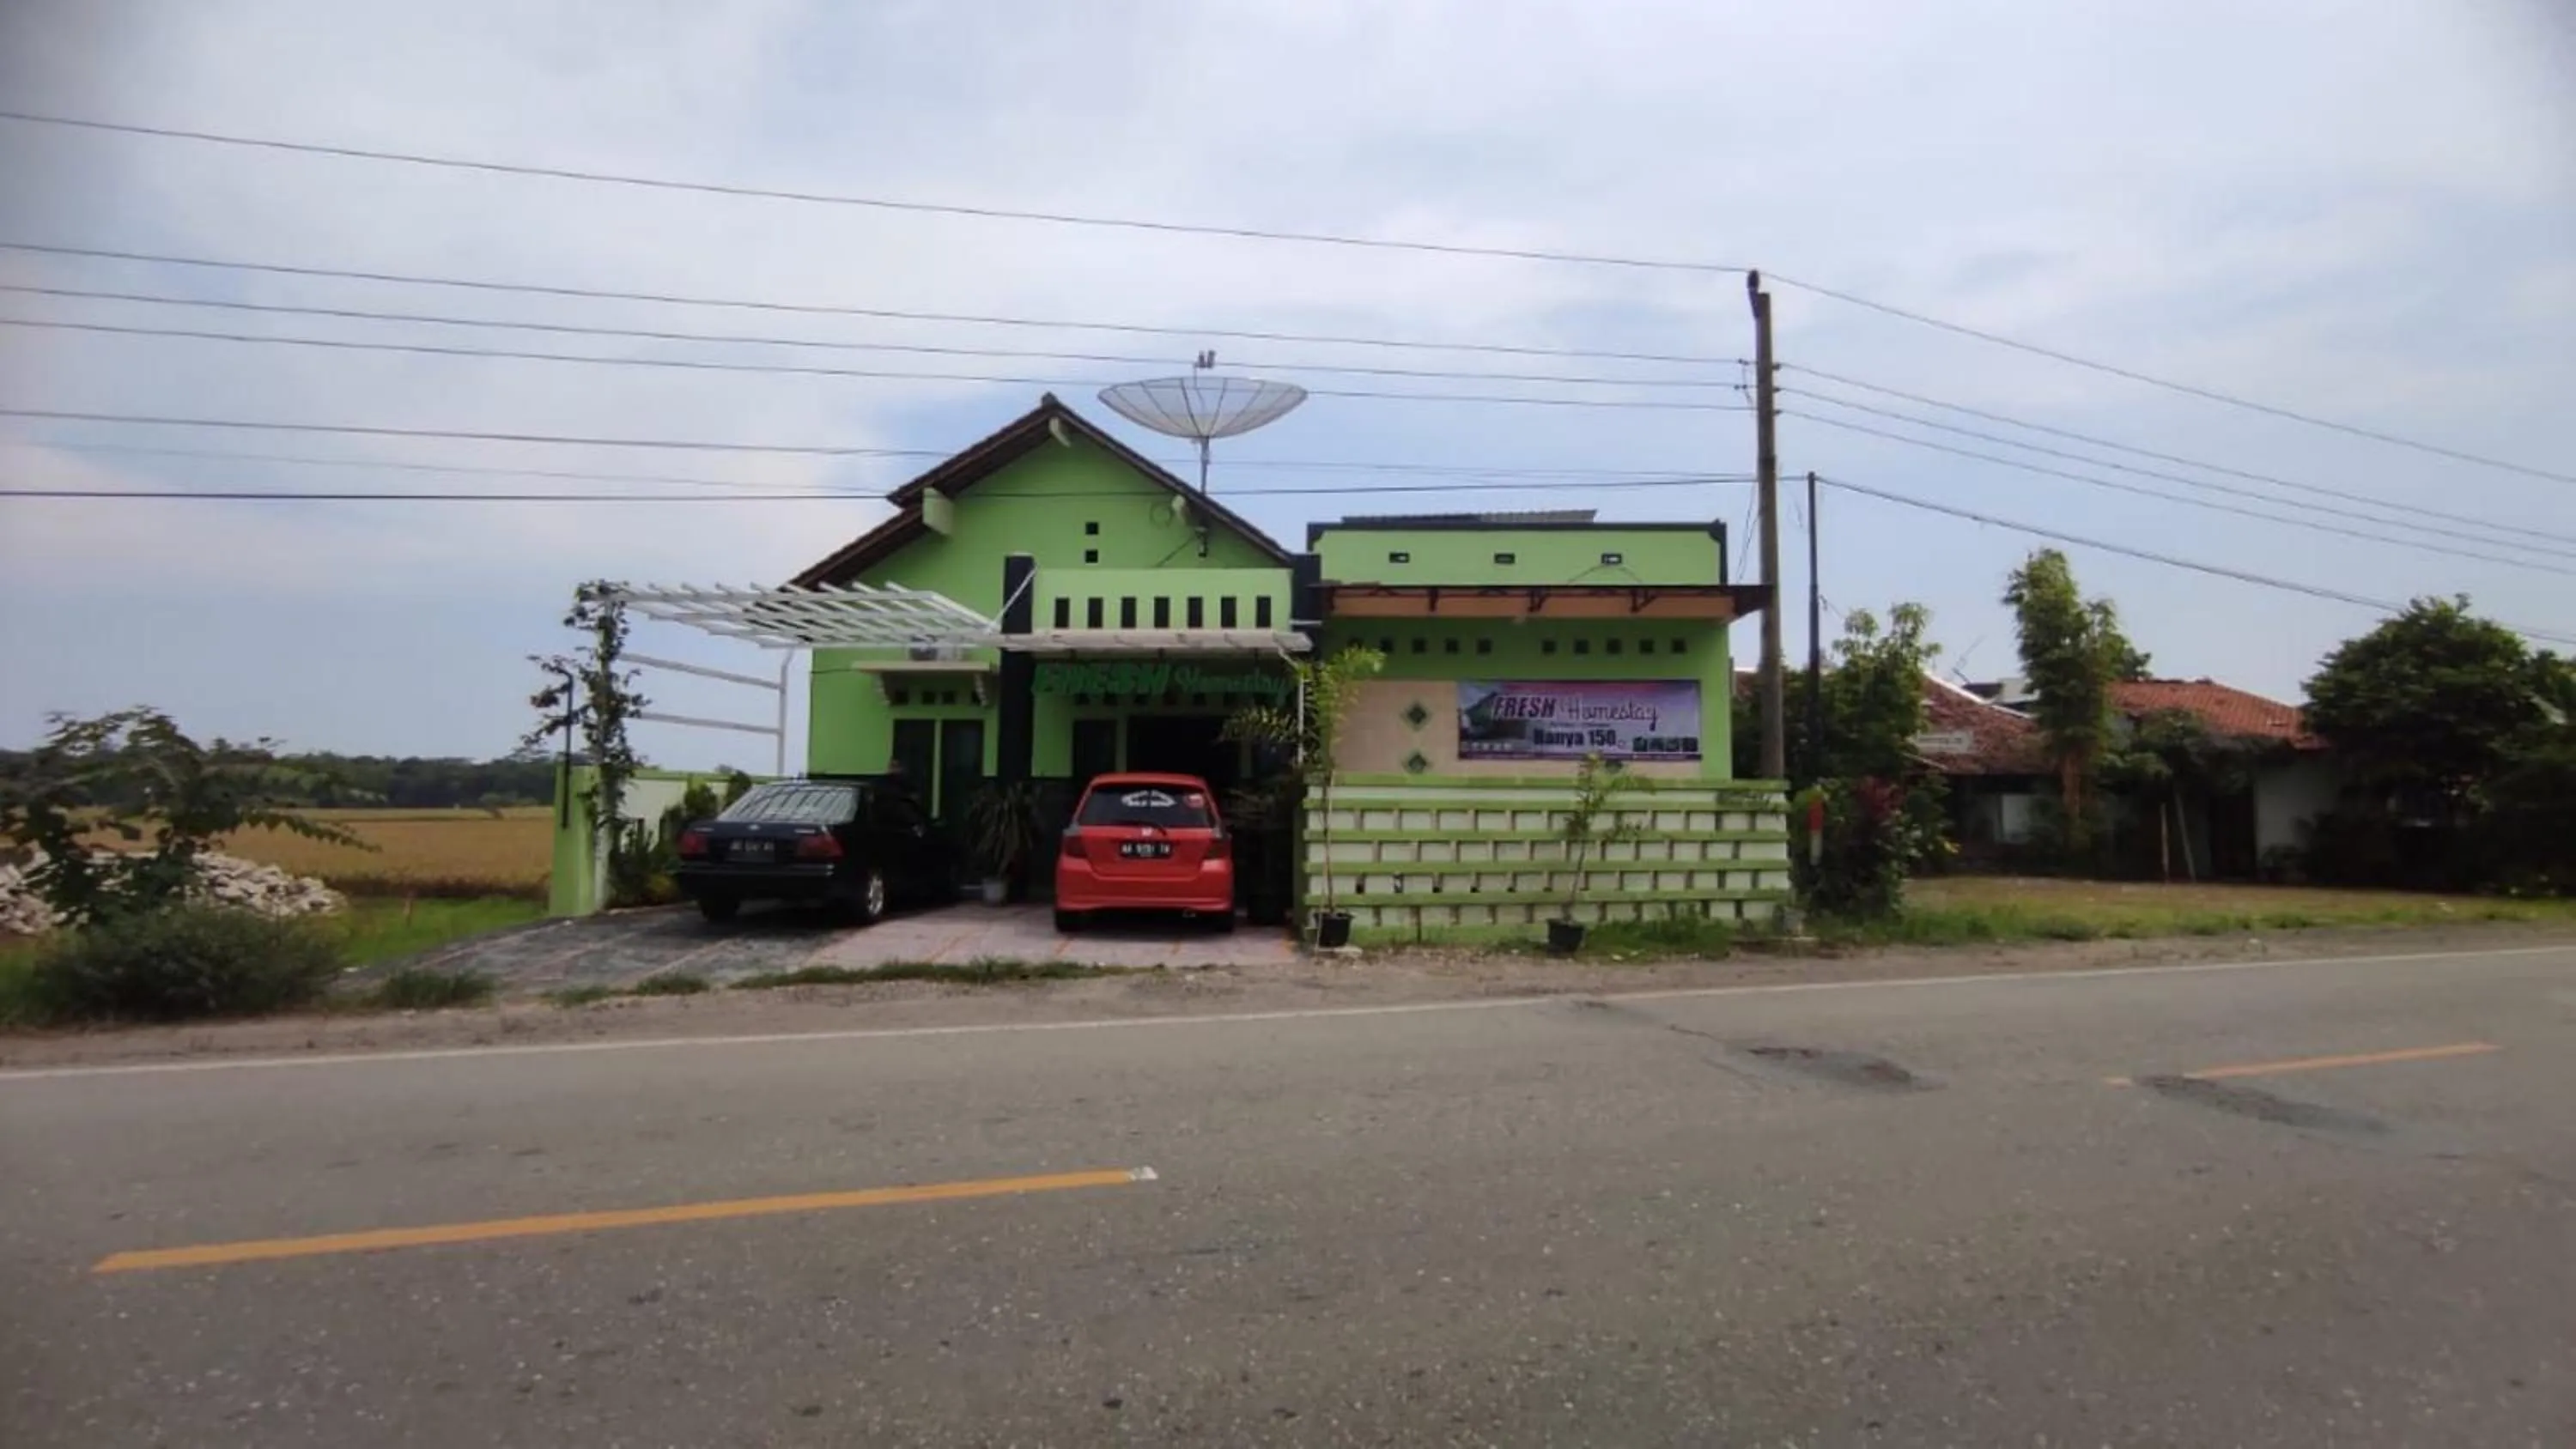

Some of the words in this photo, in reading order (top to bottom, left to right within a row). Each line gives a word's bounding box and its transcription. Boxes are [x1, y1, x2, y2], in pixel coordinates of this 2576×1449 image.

[1492, 695, 1557, 719] FRESH
[1563, 698, 1658, 731] Homestay
[1534, 729, 1584, 748] Hanya
